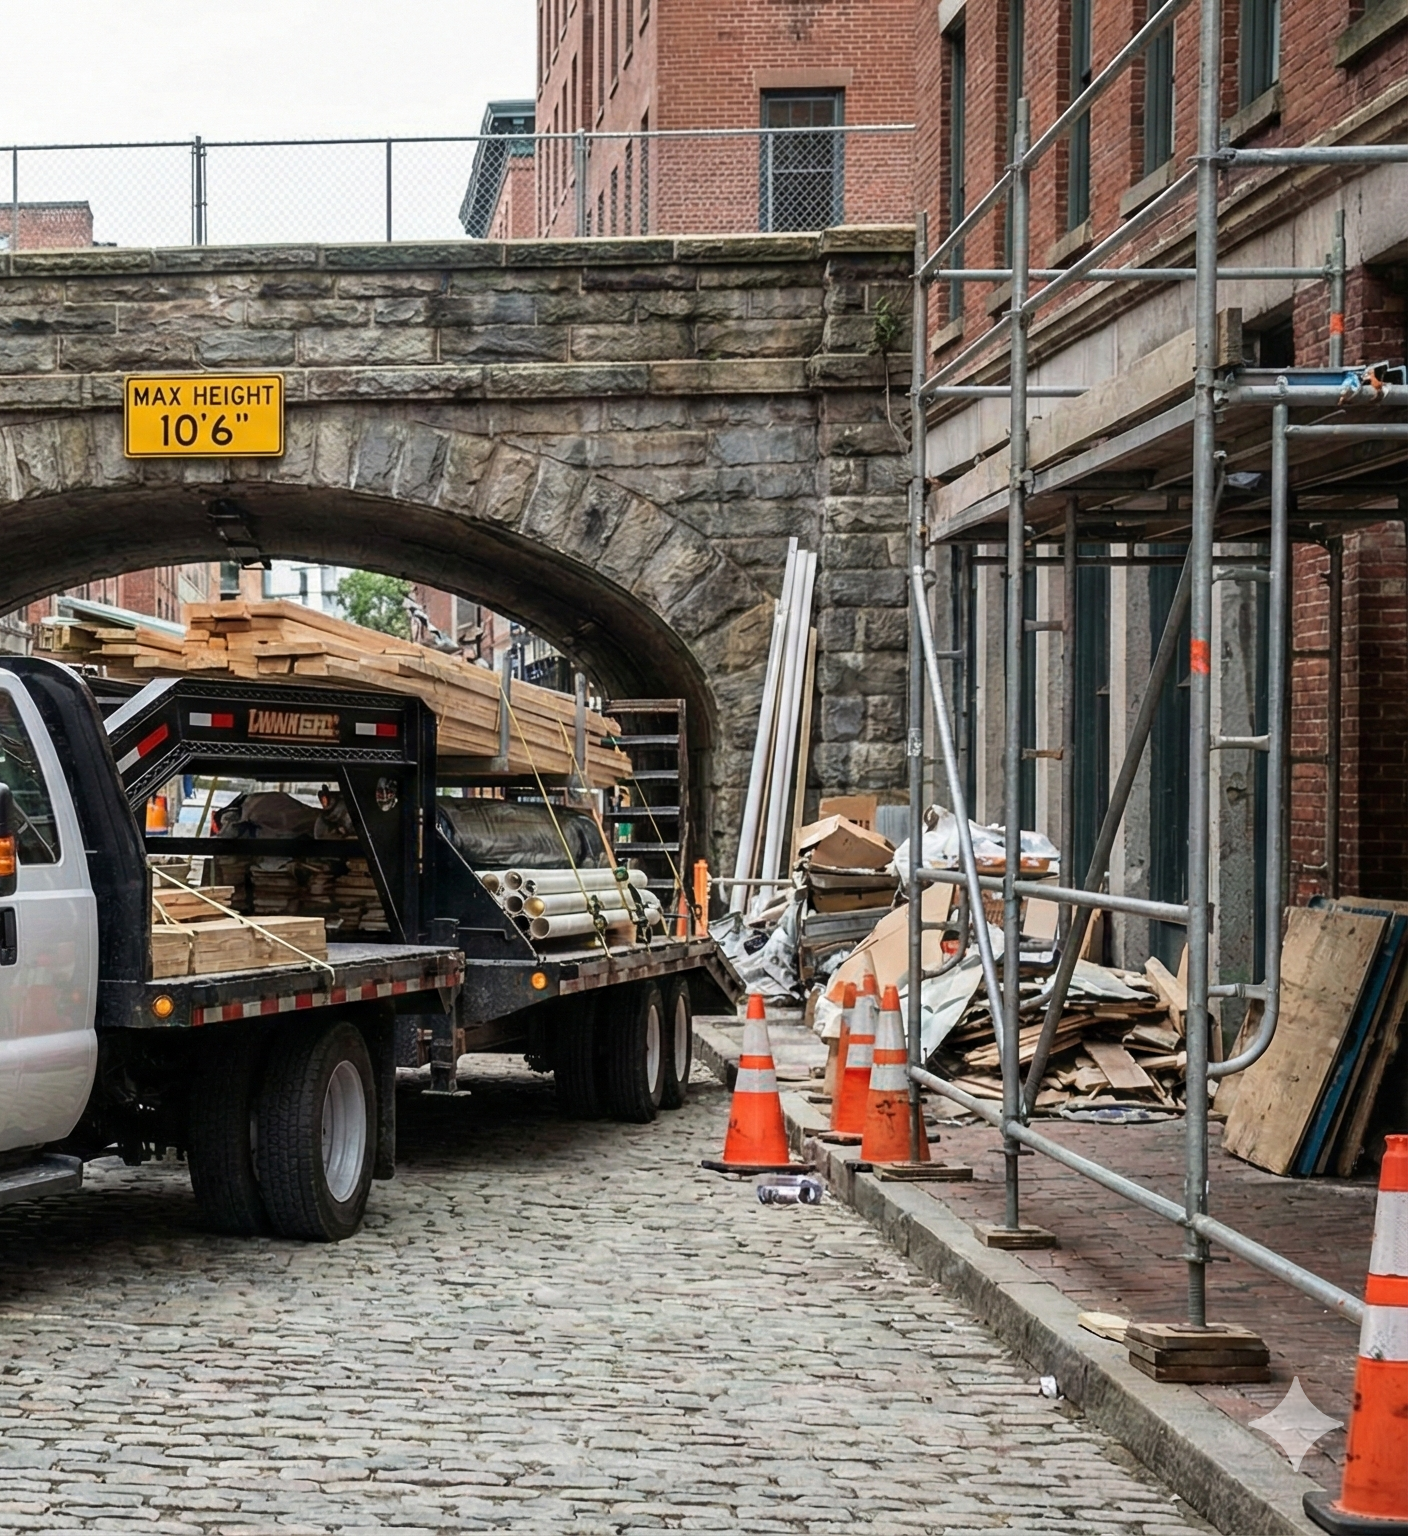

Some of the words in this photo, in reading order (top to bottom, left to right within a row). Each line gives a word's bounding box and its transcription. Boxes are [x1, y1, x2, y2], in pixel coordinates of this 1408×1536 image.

[134, 386, 181, 406] MAX
[193, 385, 274, 406] HEIGHT
[160, 412, 249, 447] 10'6"
